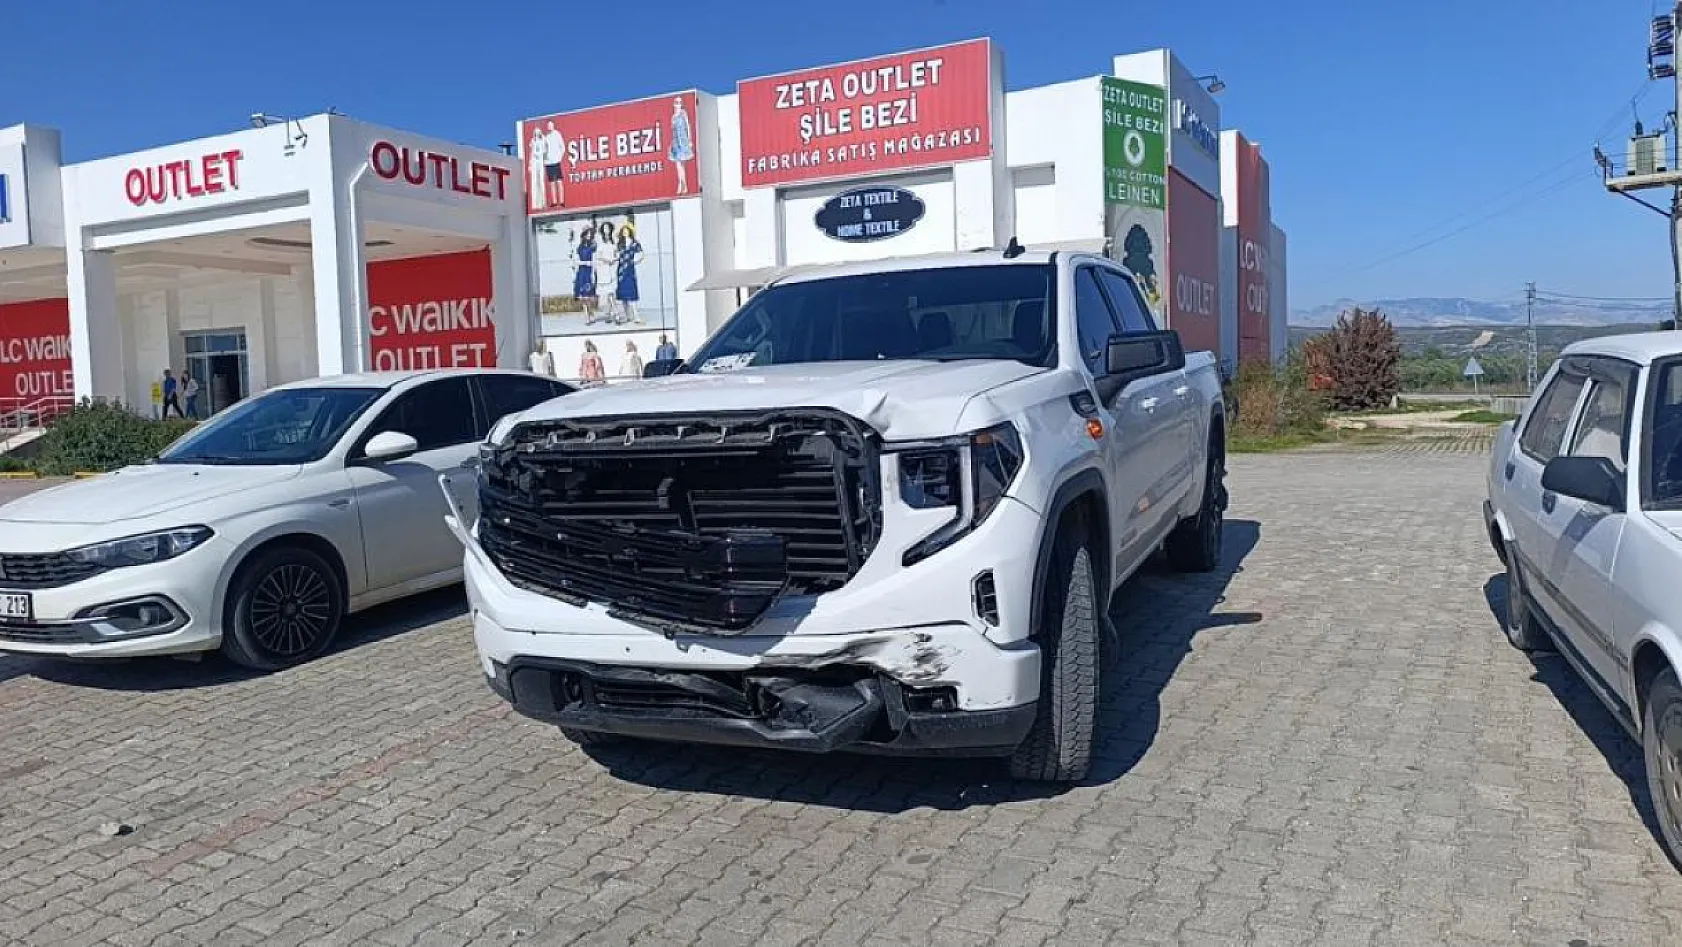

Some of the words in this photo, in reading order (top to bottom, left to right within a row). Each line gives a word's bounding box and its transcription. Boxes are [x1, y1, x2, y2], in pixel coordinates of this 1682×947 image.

[775, 84, 836, 110] ZETA
[842, 58, 944, 99] OUTLET
[1103, 84, 1127, 107] ZETA
[1129, 91, 1164, 113] OUTLET
[800, 107, 852, 145] ŞİLE
[860, 92, 918, 130] BEZİ
[568, 133, 610, 168] ŞİLE
[616, 121, 661, 156] BEZİ
[827, 141, 877, 161] SATIŞ
[125, 149, 243, 206] OUTLET
[371, 141, 511, 200] OUTLET
[1108, 181, 1160, 205] LEINEN
[15, 370, 75, 396] OUTLE
[7, 595, 27, 614] 213
